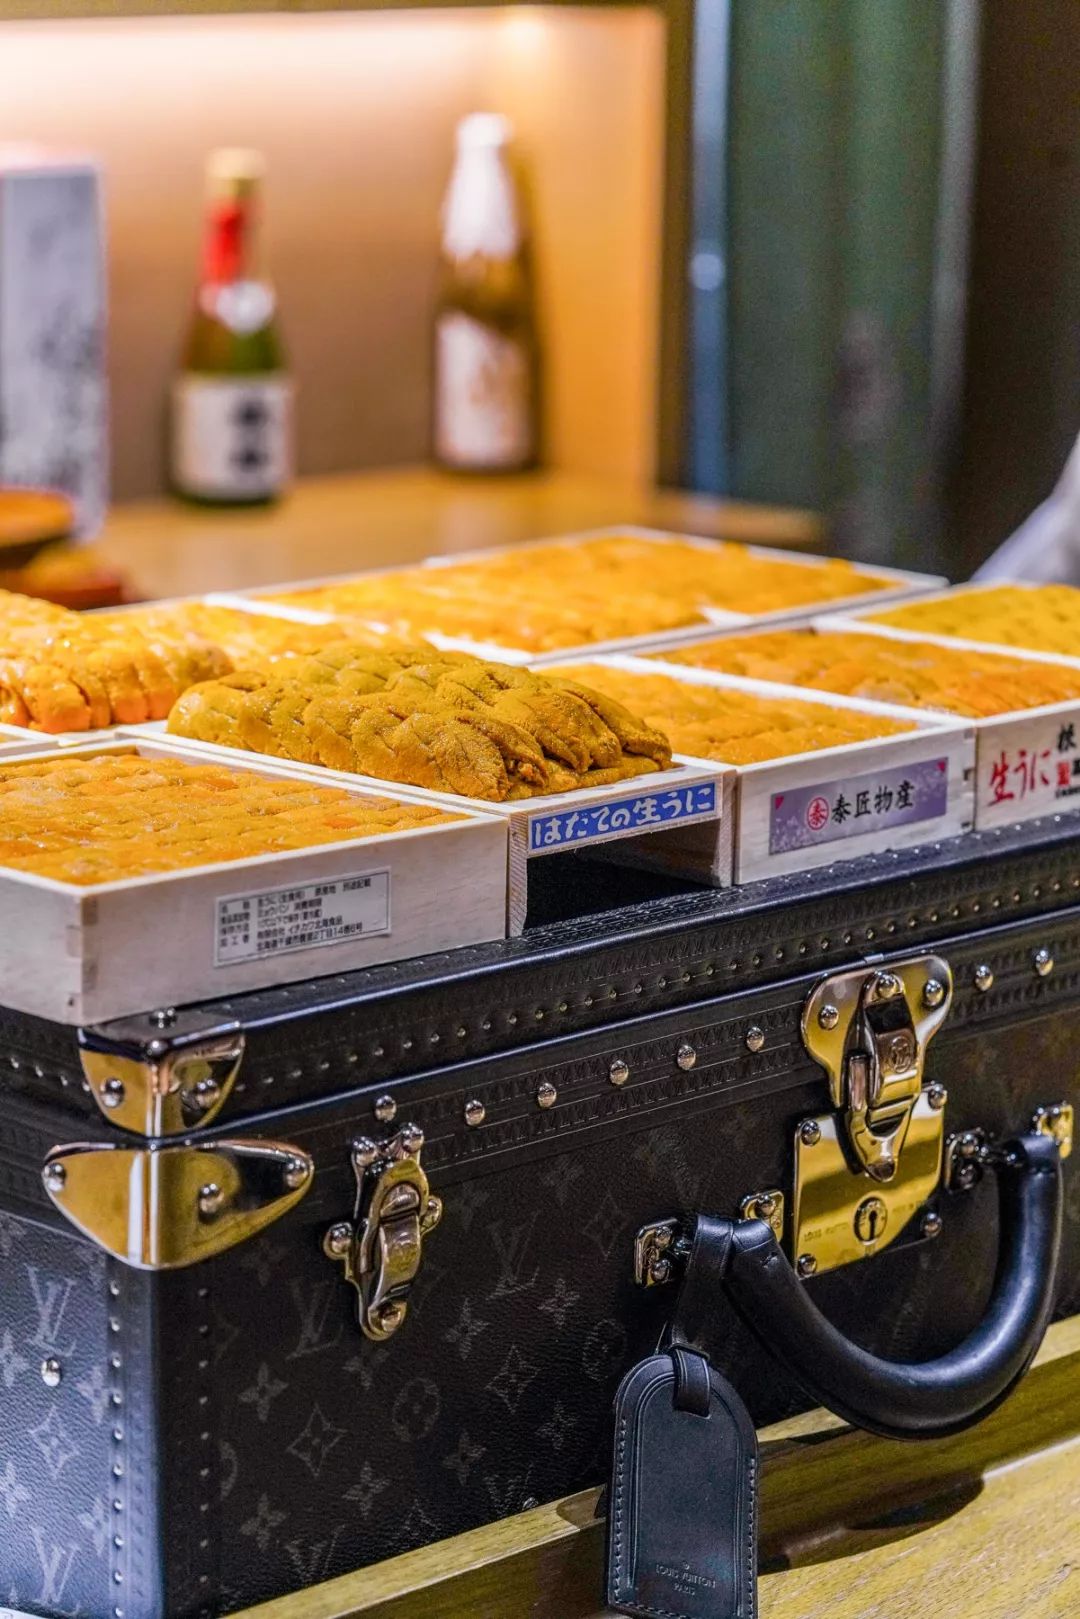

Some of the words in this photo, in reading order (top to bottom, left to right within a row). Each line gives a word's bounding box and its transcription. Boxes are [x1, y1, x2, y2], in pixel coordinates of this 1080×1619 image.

[534, 787, 712, 847] はだての生うに
